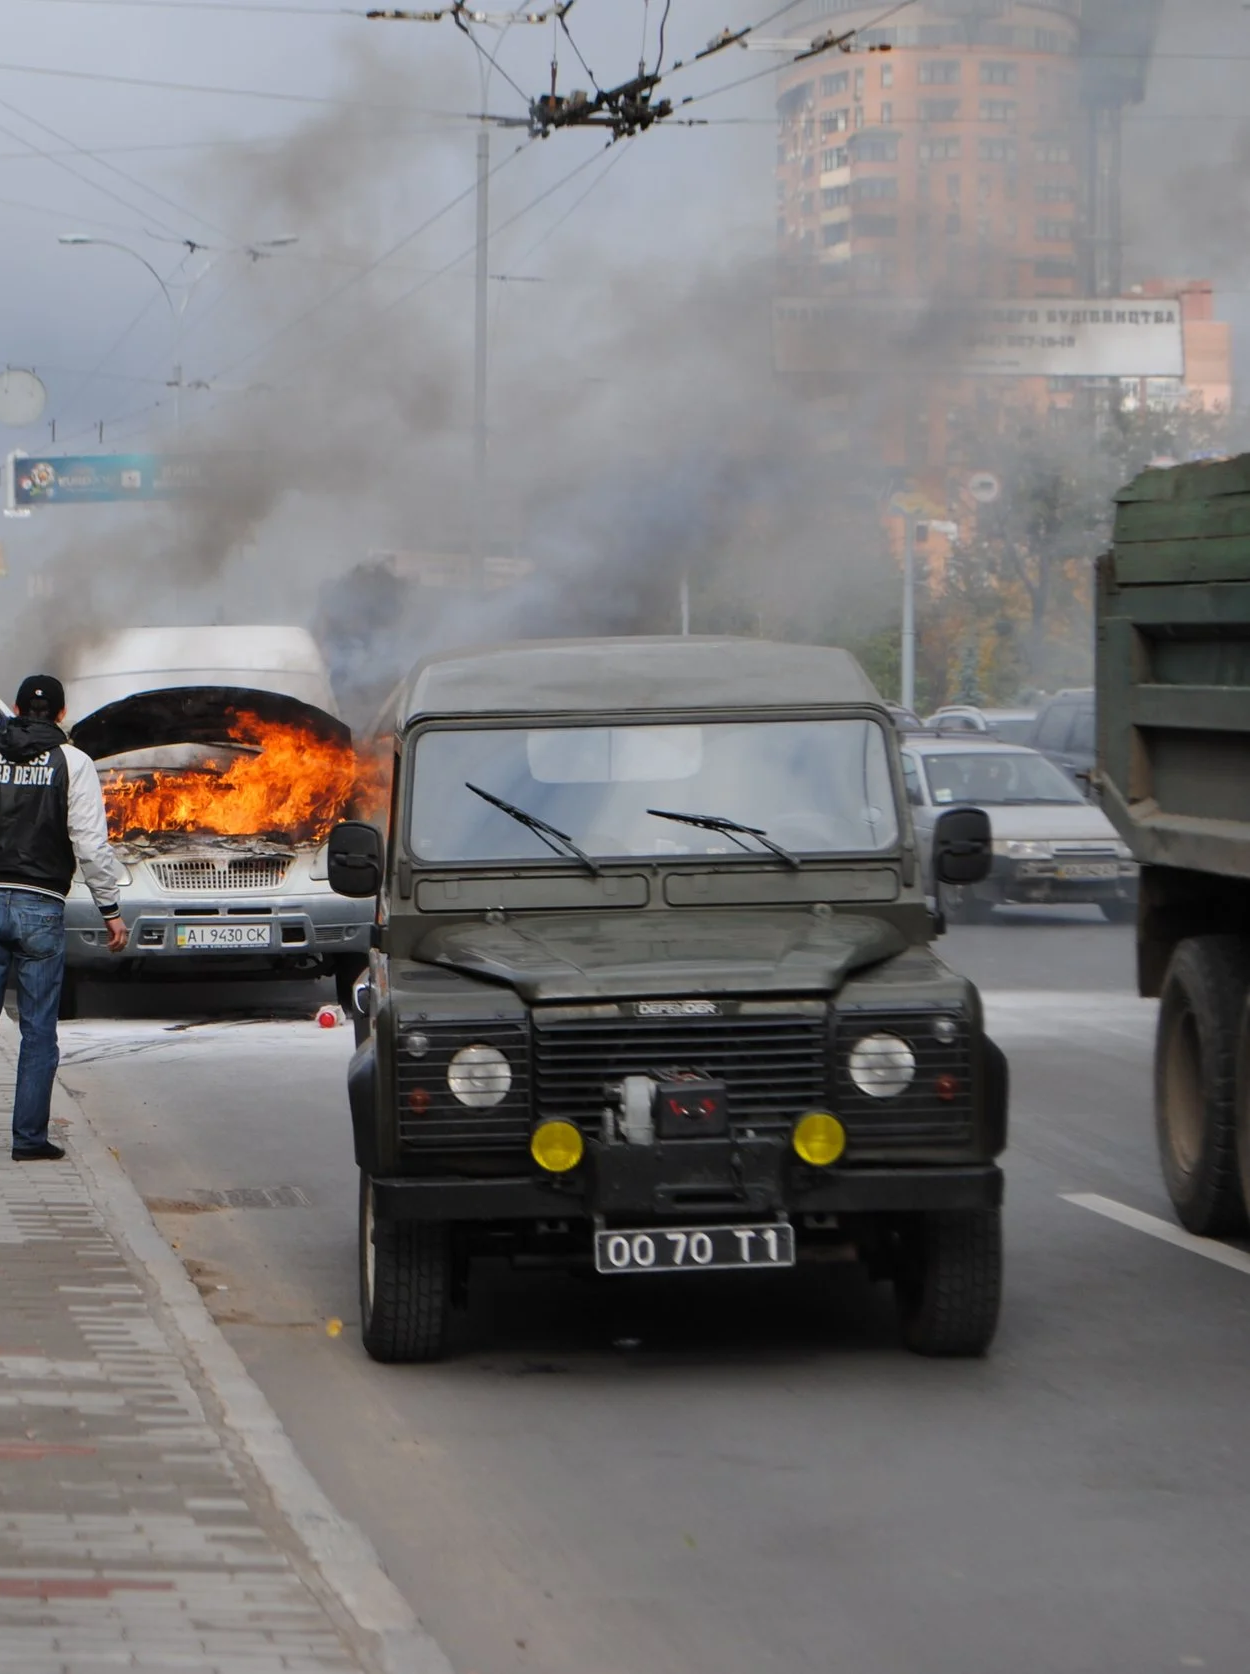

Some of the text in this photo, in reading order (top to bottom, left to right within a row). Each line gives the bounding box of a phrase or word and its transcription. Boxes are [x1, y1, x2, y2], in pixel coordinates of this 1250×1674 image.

[13, 765, 54, 785] DENIM
[210, 928, 243, 942] 9430
[664, 1231, 714, 1265] 70
